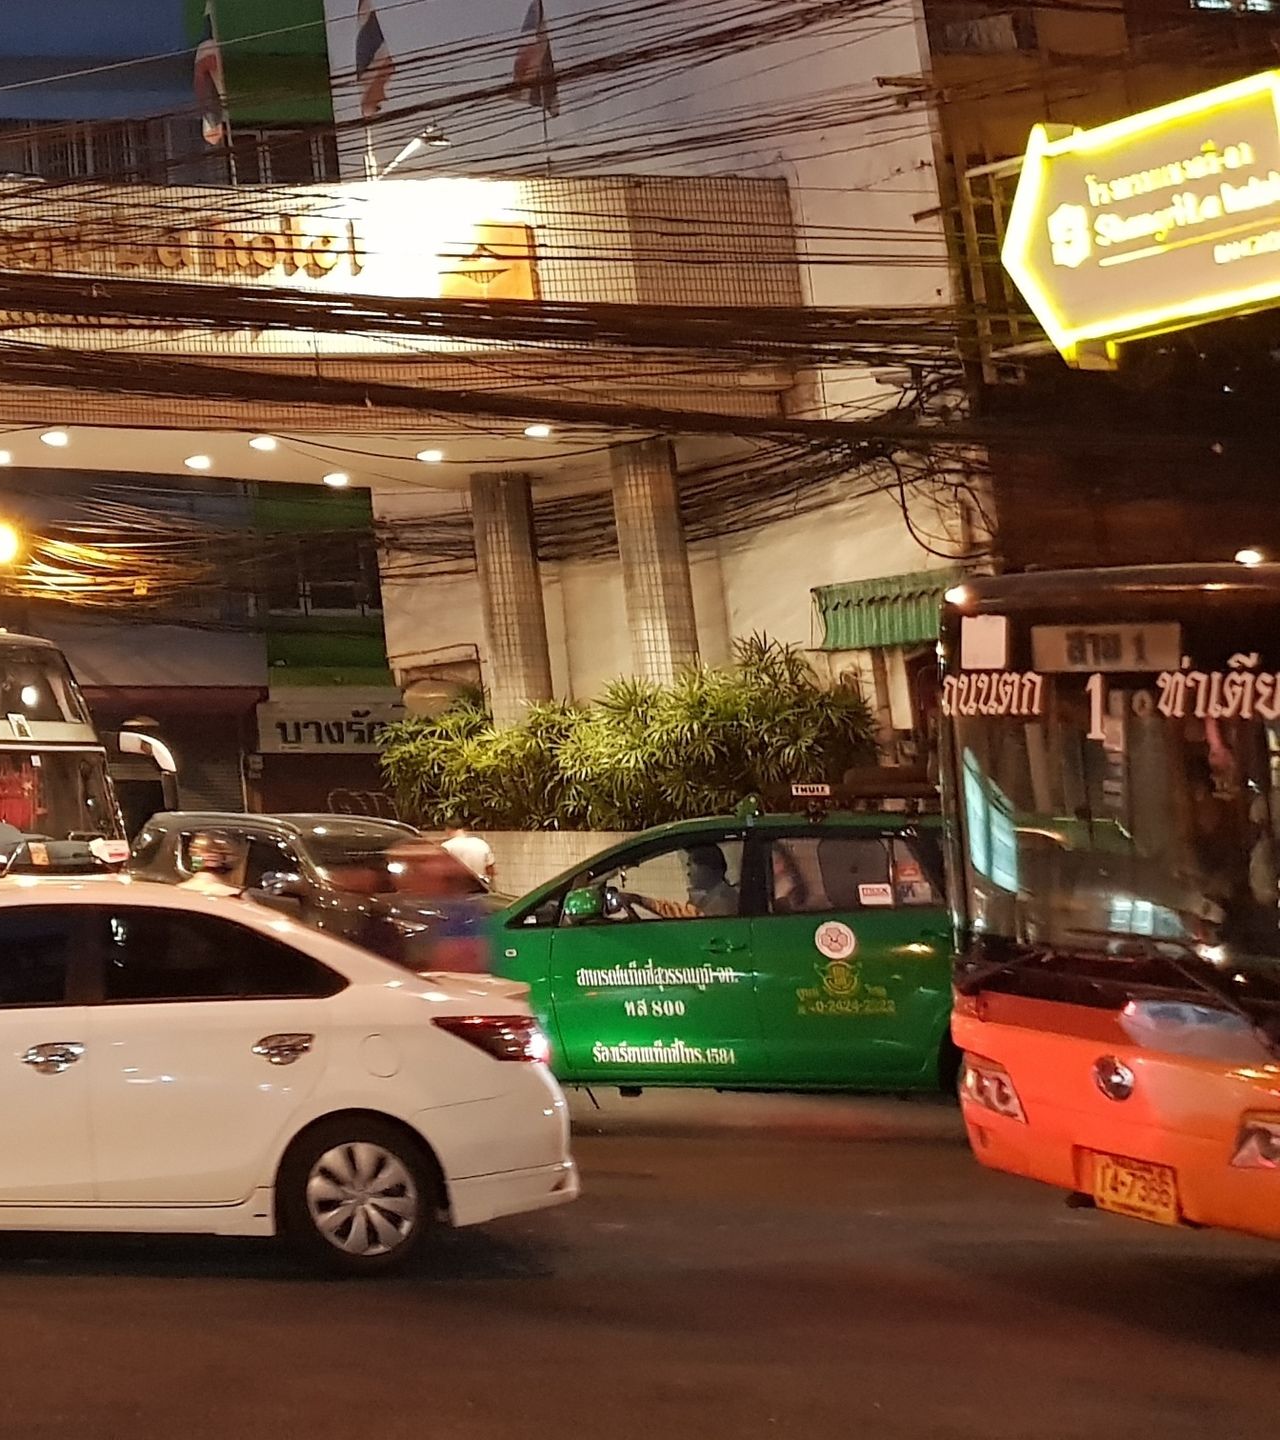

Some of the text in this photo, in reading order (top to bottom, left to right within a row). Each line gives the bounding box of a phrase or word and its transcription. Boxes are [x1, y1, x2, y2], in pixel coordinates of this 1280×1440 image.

[942, 671, 1043, 717] ถนนตก
[1085, 672, 1107, 740] 1
[651, 999, 686, 1018] 800
